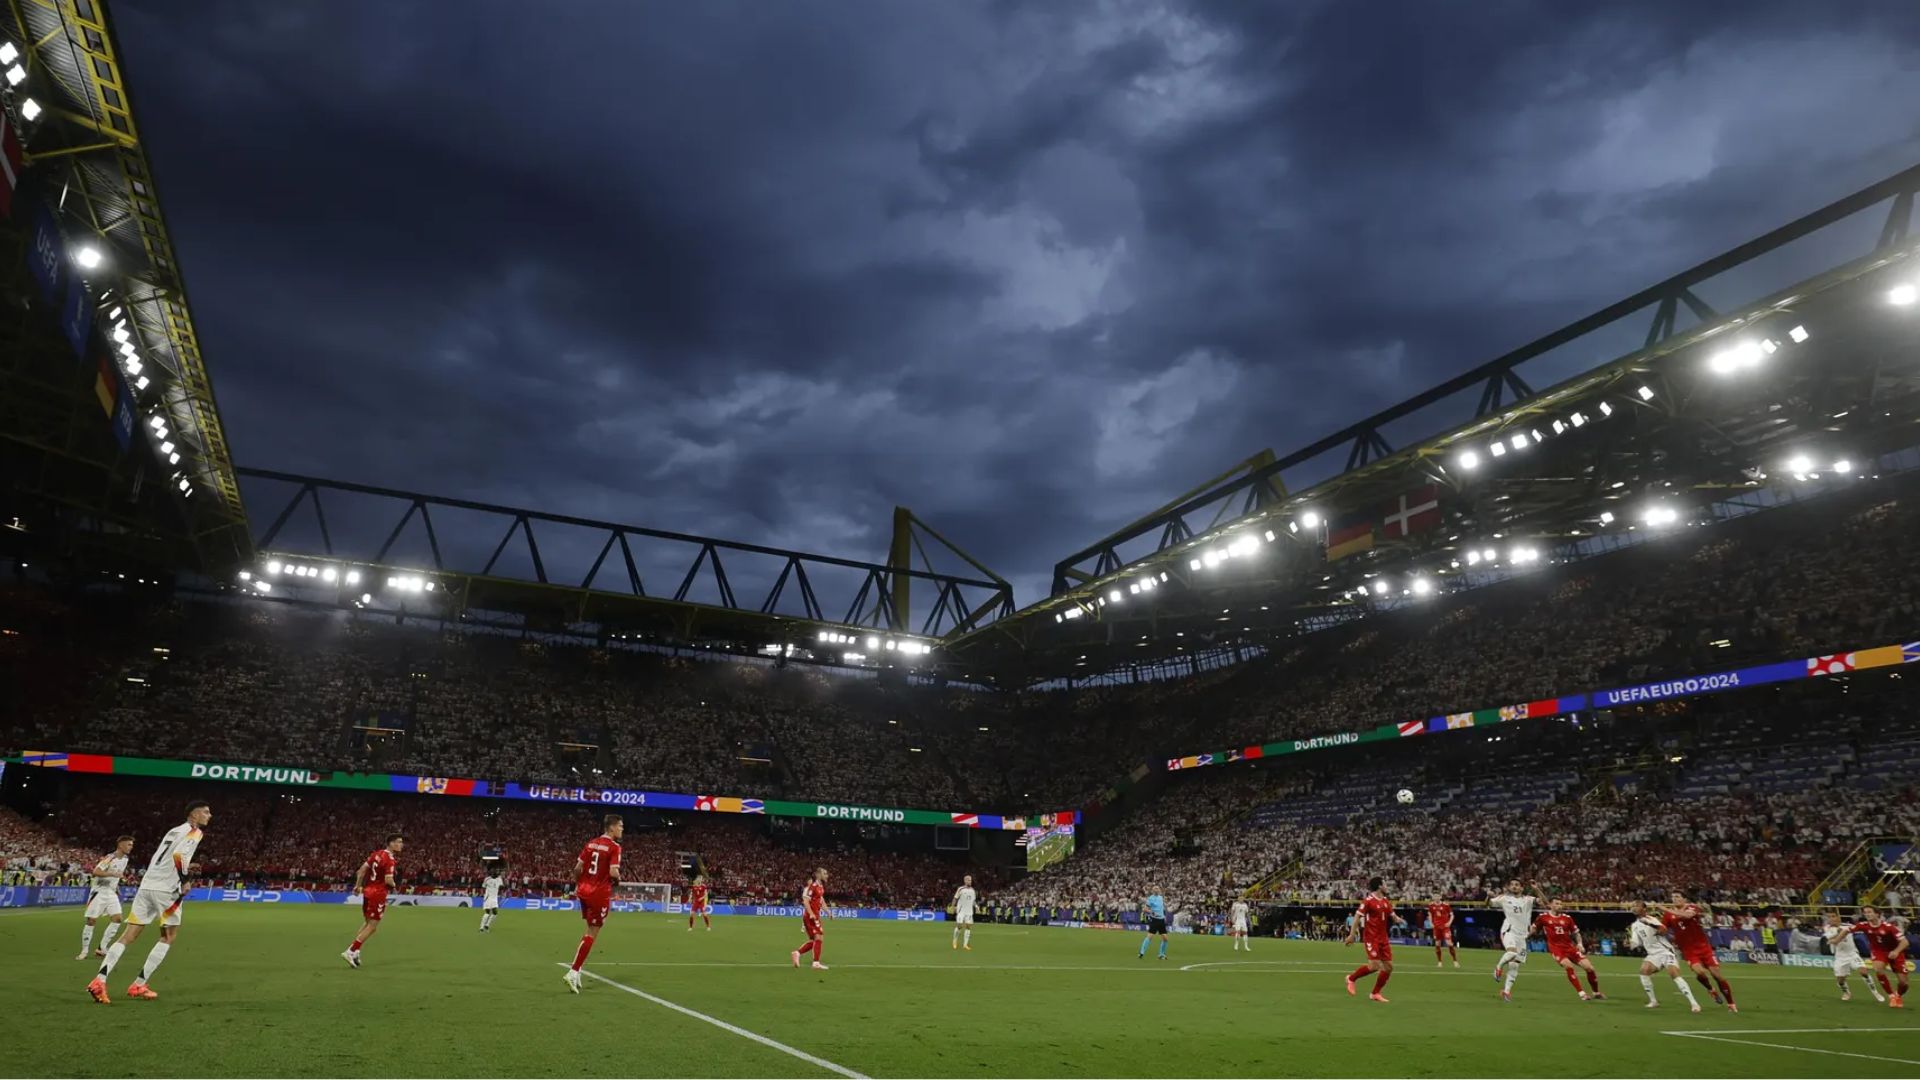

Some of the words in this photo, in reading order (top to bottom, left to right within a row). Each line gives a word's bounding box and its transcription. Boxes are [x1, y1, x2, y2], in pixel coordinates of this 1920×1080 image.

[36, 226, 59, 285] UEFA
[1294, 732, 1359, 751] DORTMUND
[191, 764, 320, 784] DORTMUND
[529, 786, 646, 805] UEFAEUO2024
[817, 805, 904, 822] DORTMUND
[155, 840, 173, 866] 7
[588, 851, 599, 875] 3
[222, 889, 282, 902] BYD
[525, 898, 575, 911] BYD
[756, 906, 786, 916] BUILD
[819, 908, 858, 918] DEAMS
[1512, 905, 1523, 914] 21
[897, 910, 936, 921] BYD
[1748, 952, 1779, 963] QATAR
[1783, 954, 1835, 968] Hisen
